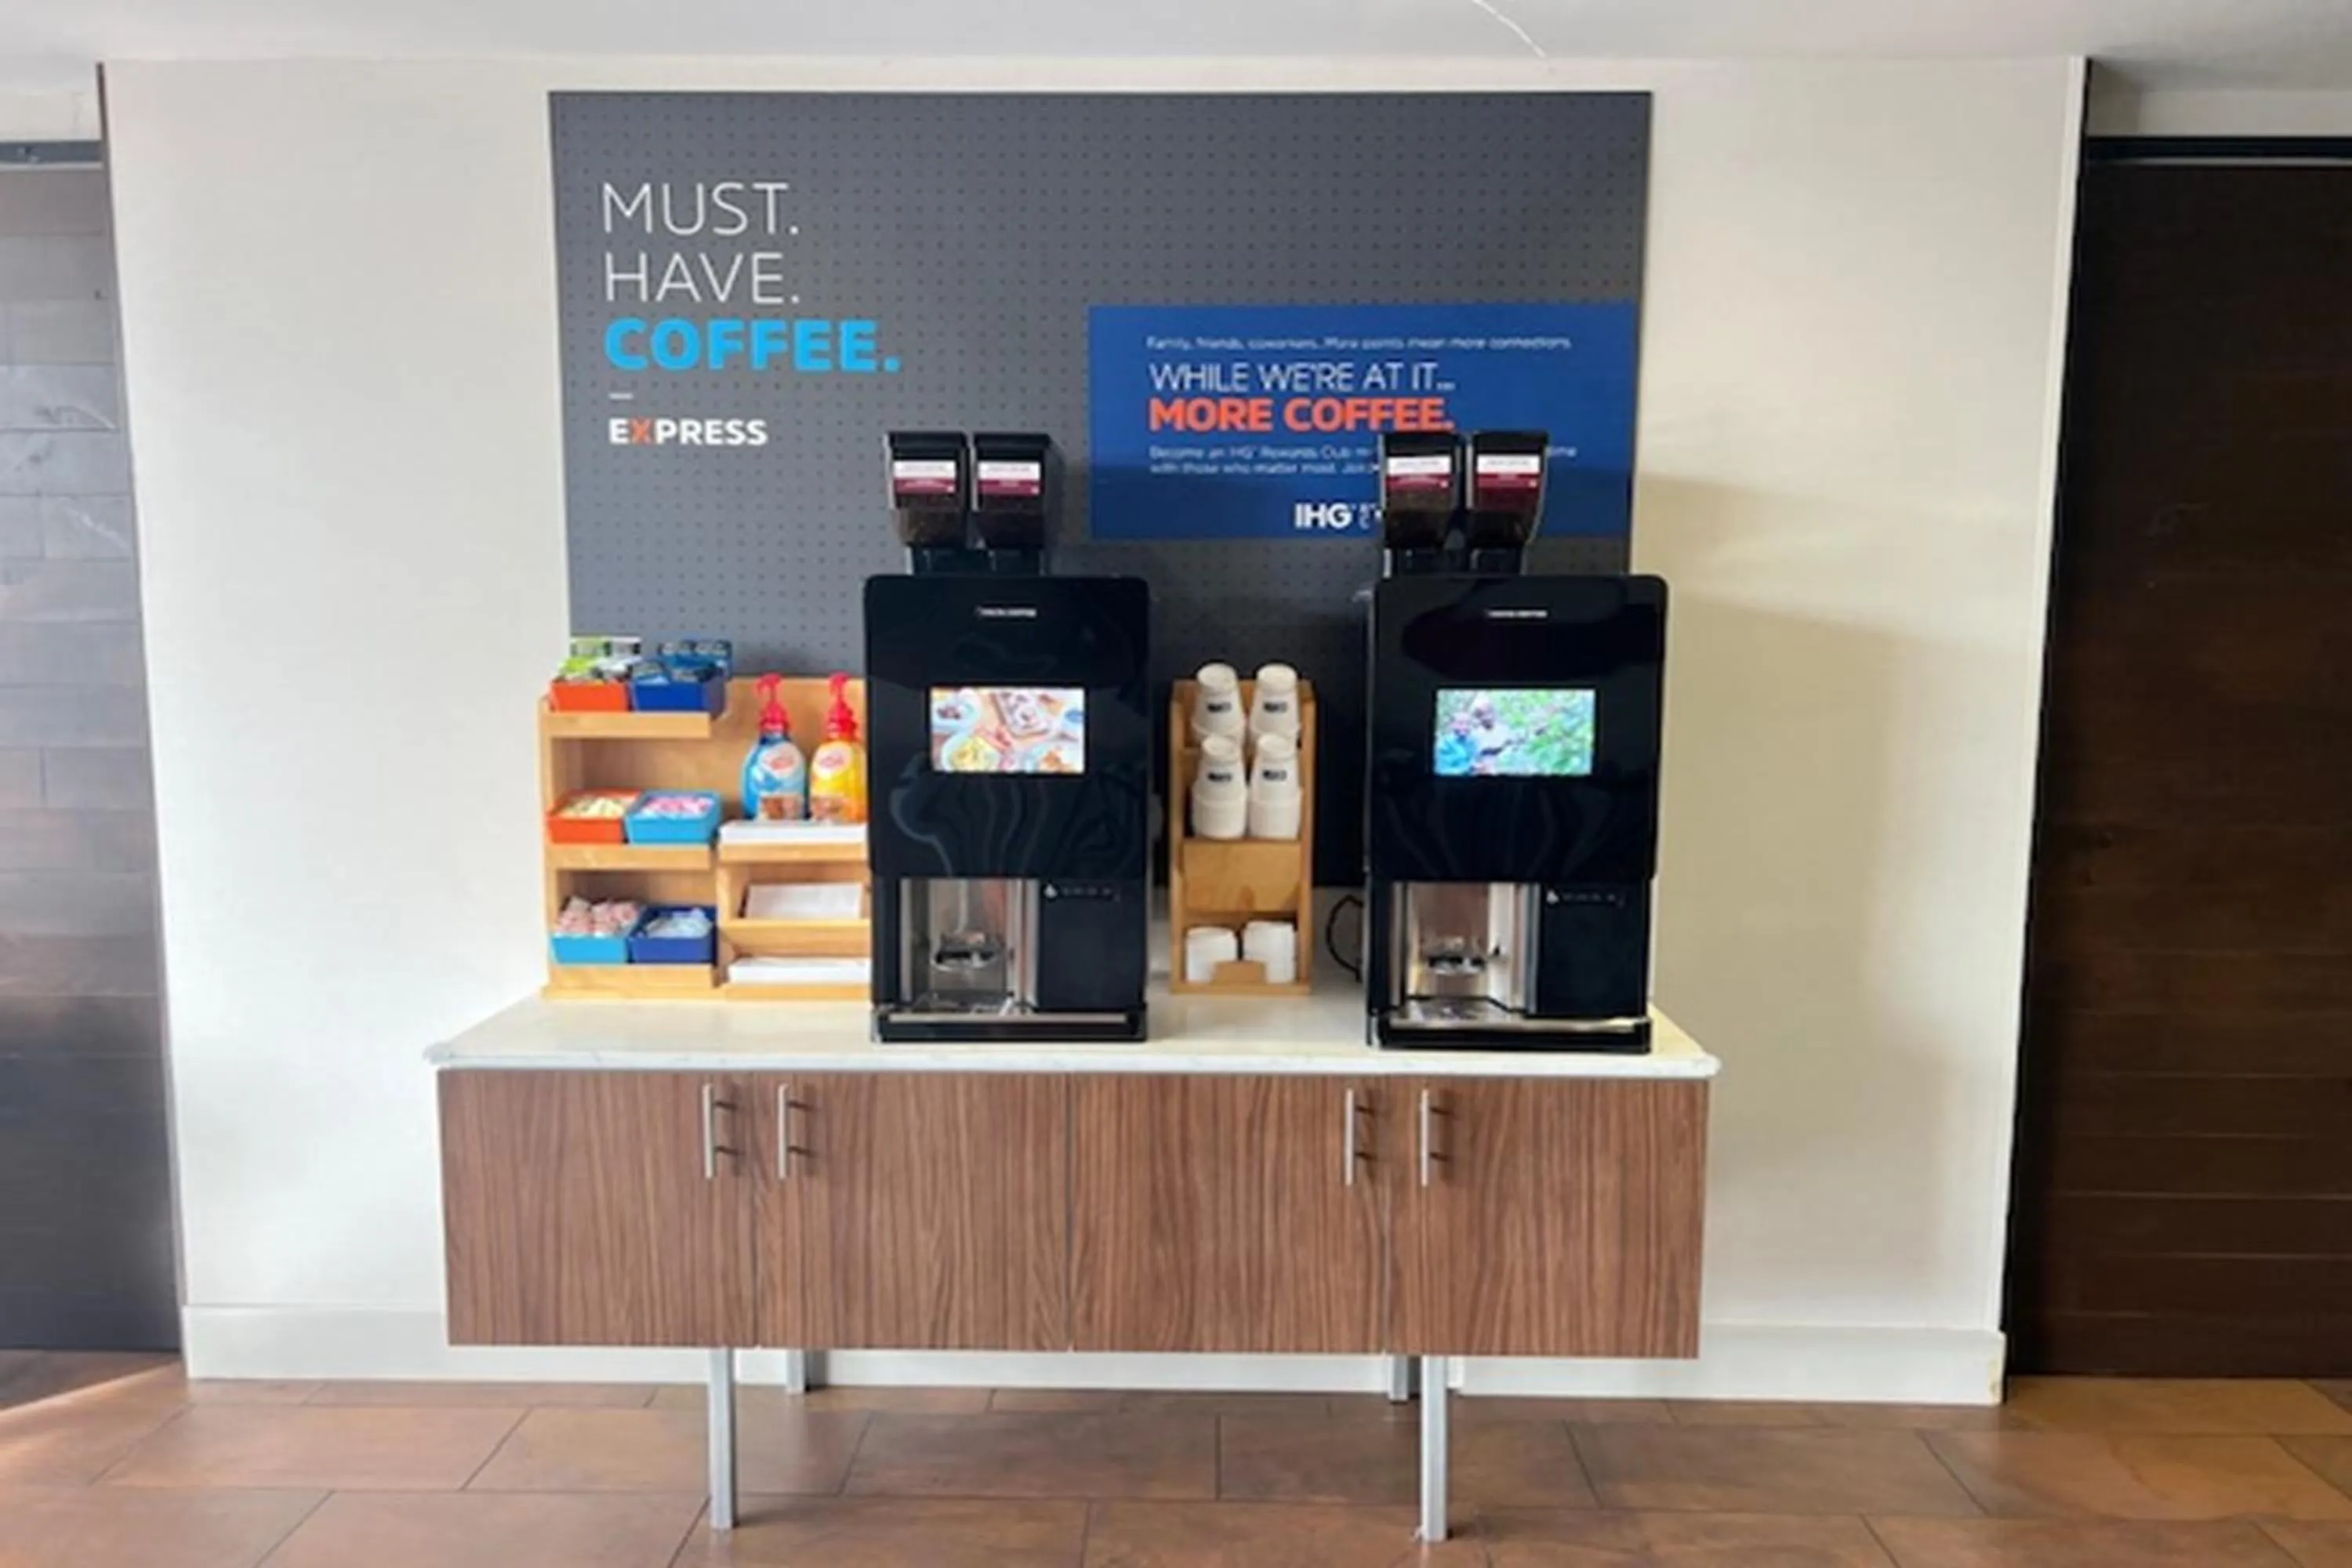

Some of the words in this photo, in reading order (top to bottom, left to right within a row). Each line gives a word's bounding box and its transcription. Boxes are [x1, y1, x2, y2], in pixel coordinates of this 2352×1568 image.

[602, 182, 800, 235] MUST.
[604, 251, 800, 304] HAVE.
[604, 318, 902, 372] COFFEE.
[1149, 362, 1250, 391] WHILE
[1258, 362, 1355, 391] WE'RE
[1362, 362, 1404, 391] AT
[608, 418, 768, 446] EXPRESS
[1149, 397, 1273, 432] MORE
[1283, 397, 1455, 432] COFFEE.
